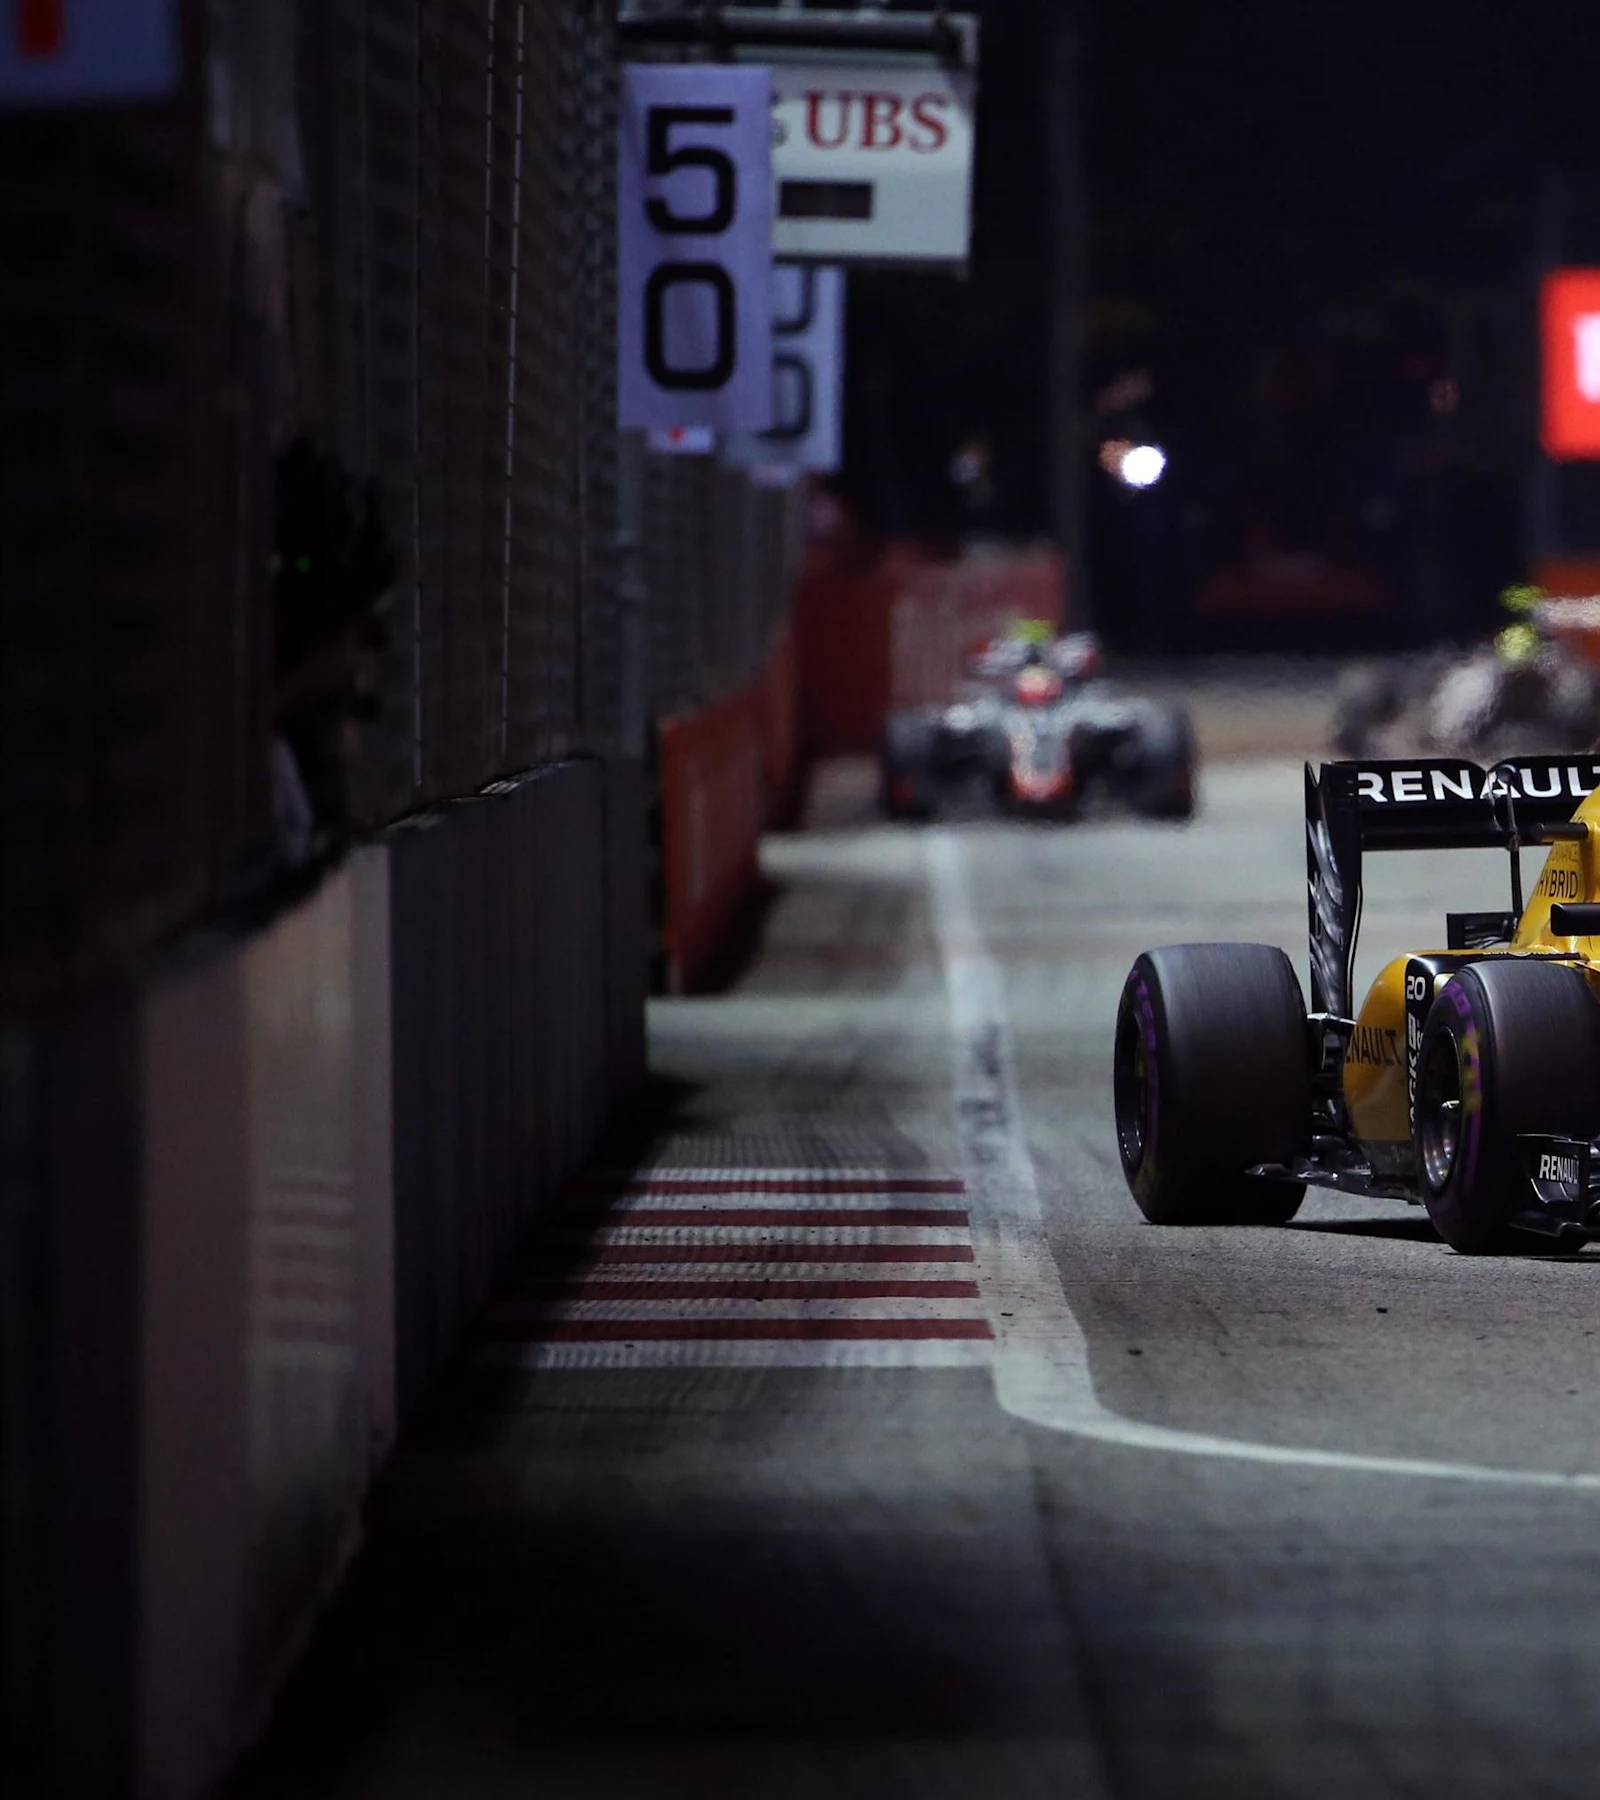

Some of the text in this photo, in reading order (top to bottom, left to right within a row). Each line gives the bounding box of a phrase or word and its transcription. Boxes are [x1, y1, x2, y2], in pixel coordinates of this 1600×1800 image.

[804, 88, 950, 153] UBS
[645, 107, 736, 391] 50
[1407, 975, 1426, 1001] 20
